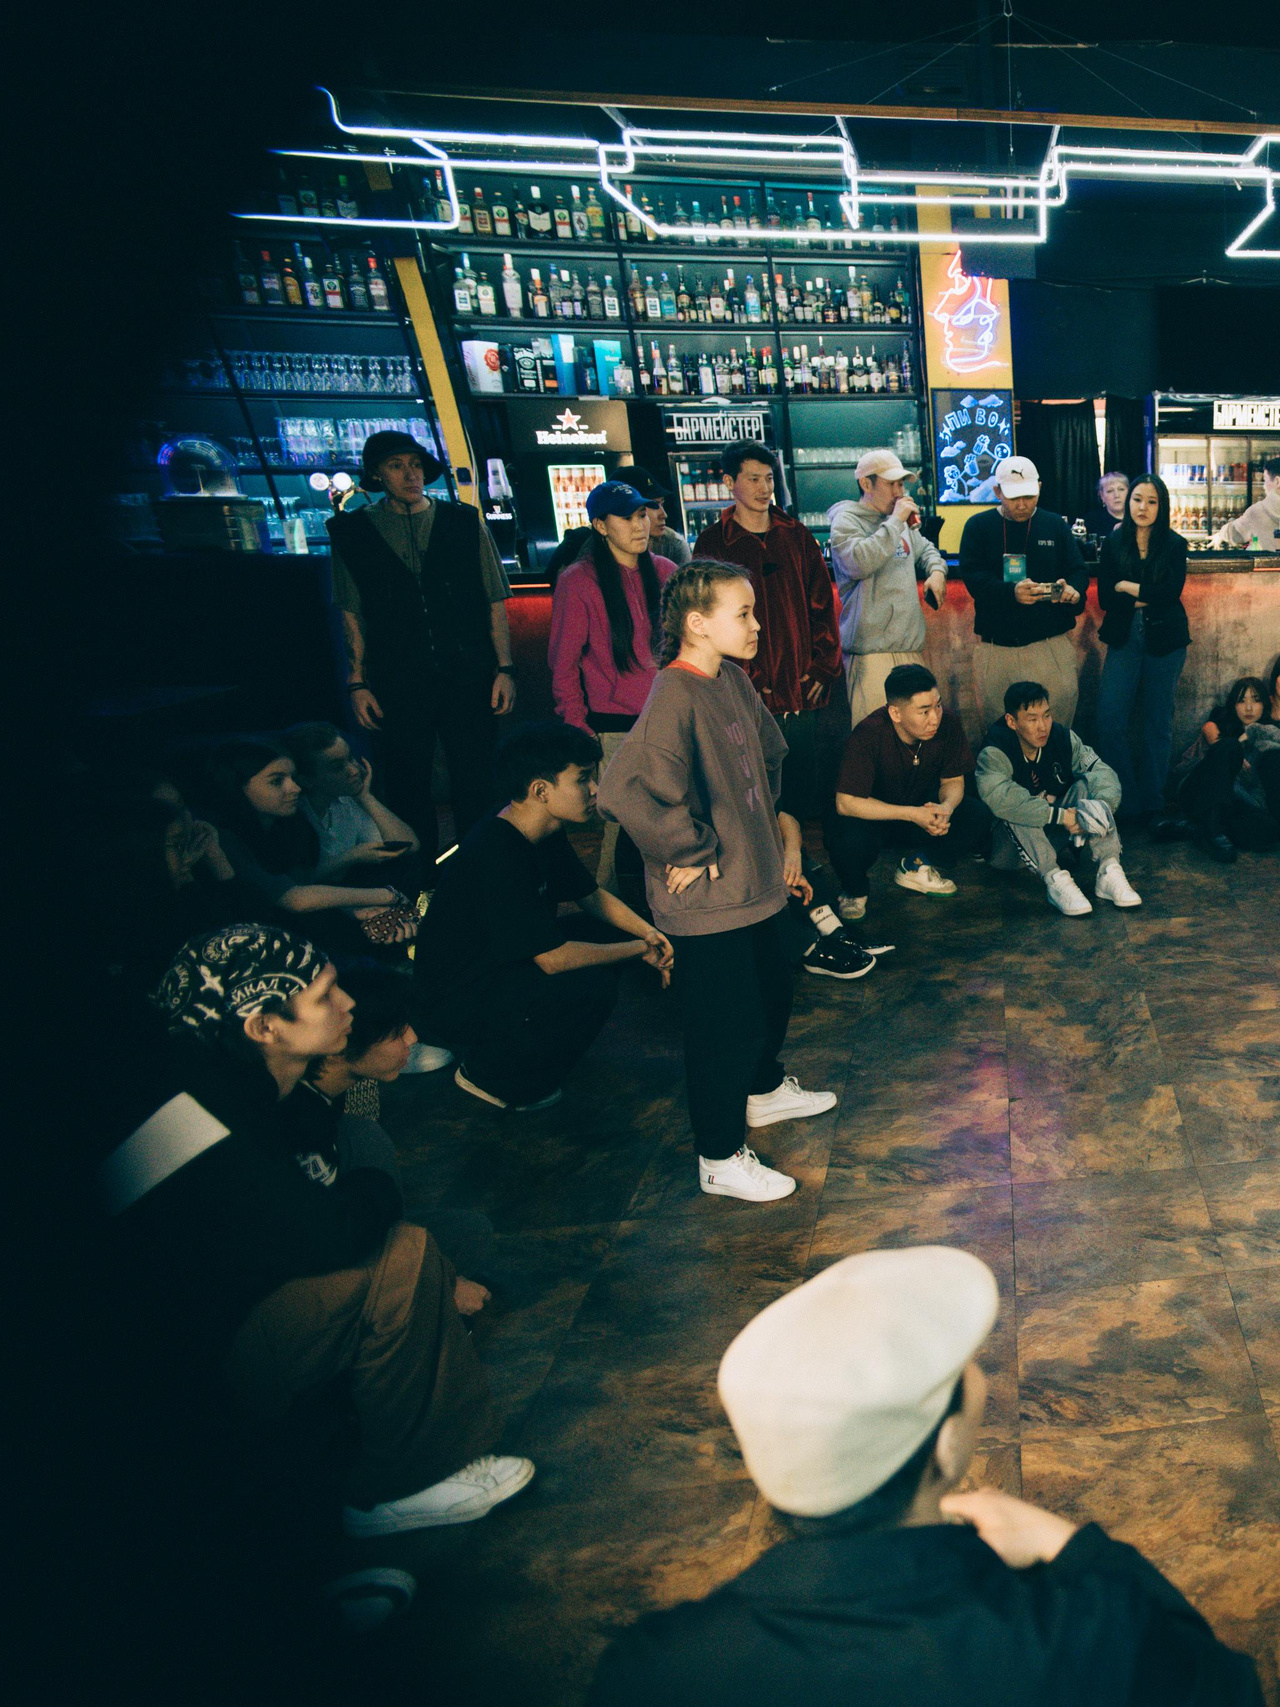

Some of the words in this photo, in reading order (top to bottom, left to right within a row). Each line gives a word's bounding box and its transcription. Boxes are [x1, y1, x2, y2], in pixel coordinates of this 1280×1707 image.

[535, 430, 608, 445] Heineken
[672, 412, 763, 442] БАРМЕЙСТЕР
[231, 977, 279, 1005] ЙКАЛ
